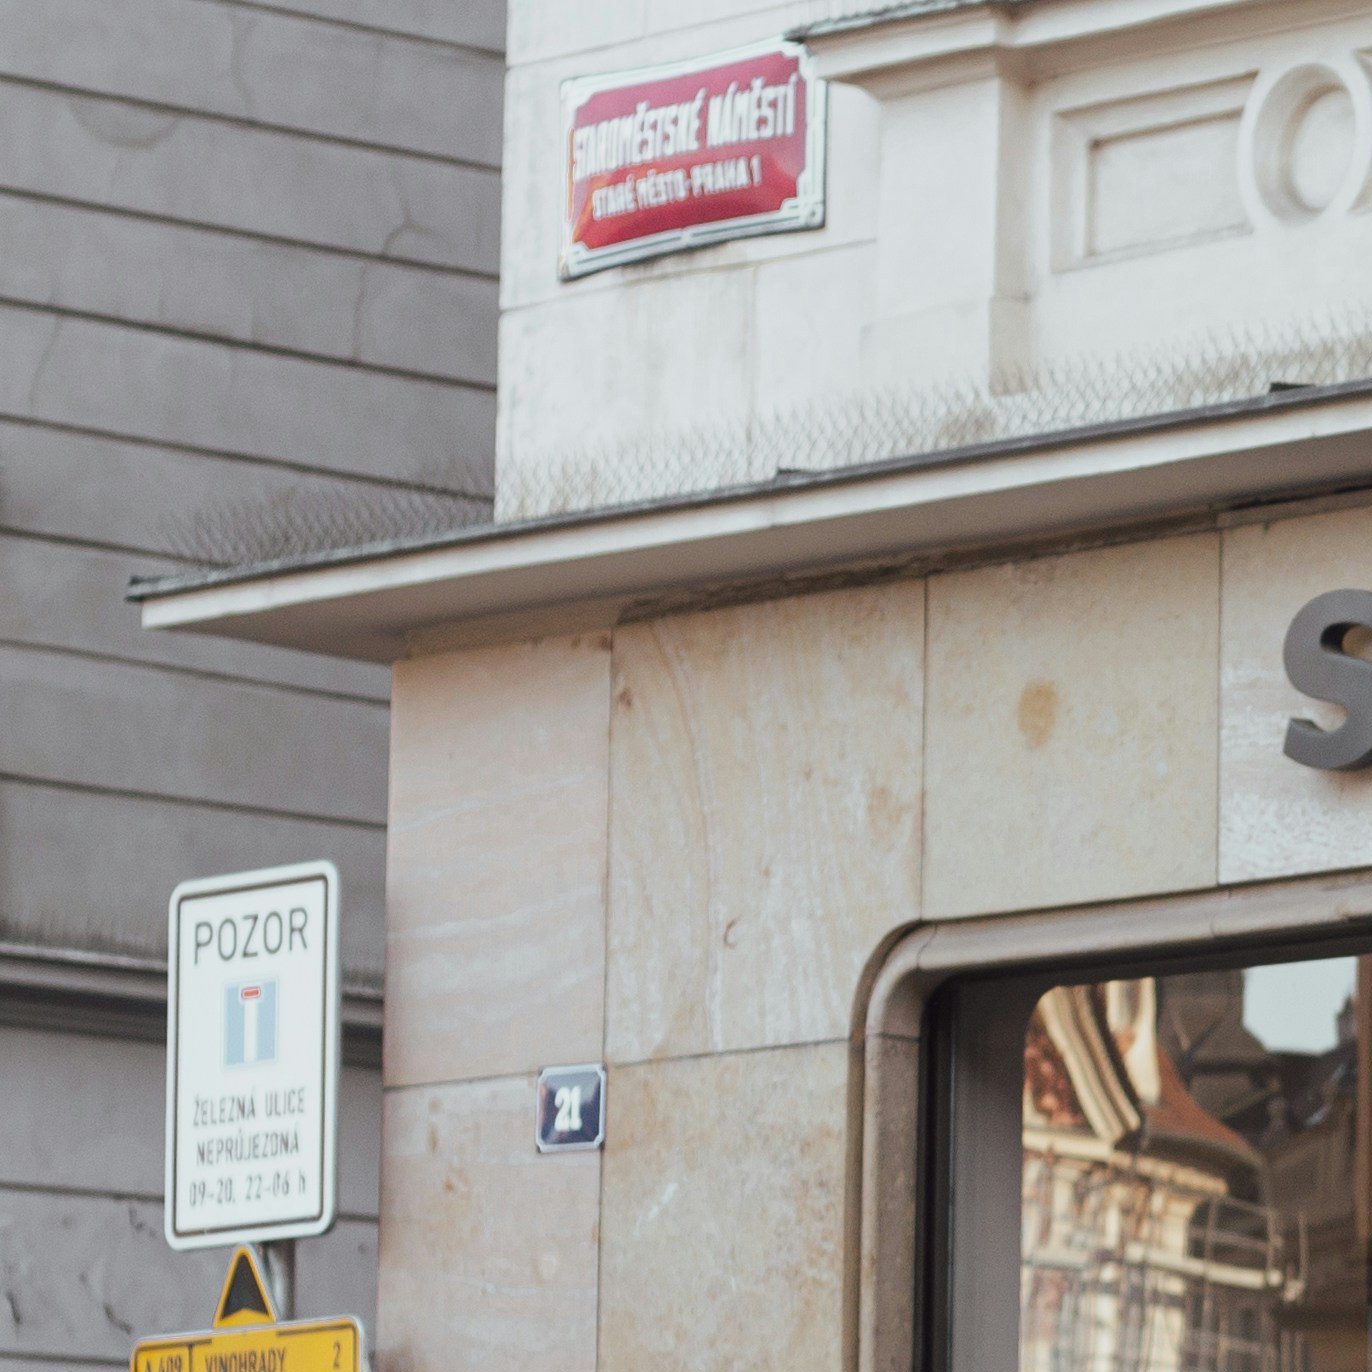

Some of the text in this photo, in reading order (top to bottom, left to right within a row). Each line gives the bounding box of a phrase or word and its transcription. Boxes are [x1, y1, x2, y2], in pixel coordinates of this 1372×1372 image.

[194, 907, 308, 966] POZOR
[193, 1086, 305, 1127] ŽELEZNÁ ULICE
[554, 1085, 582, 1132] 21
[332, 1340, 341, 1369] 2
